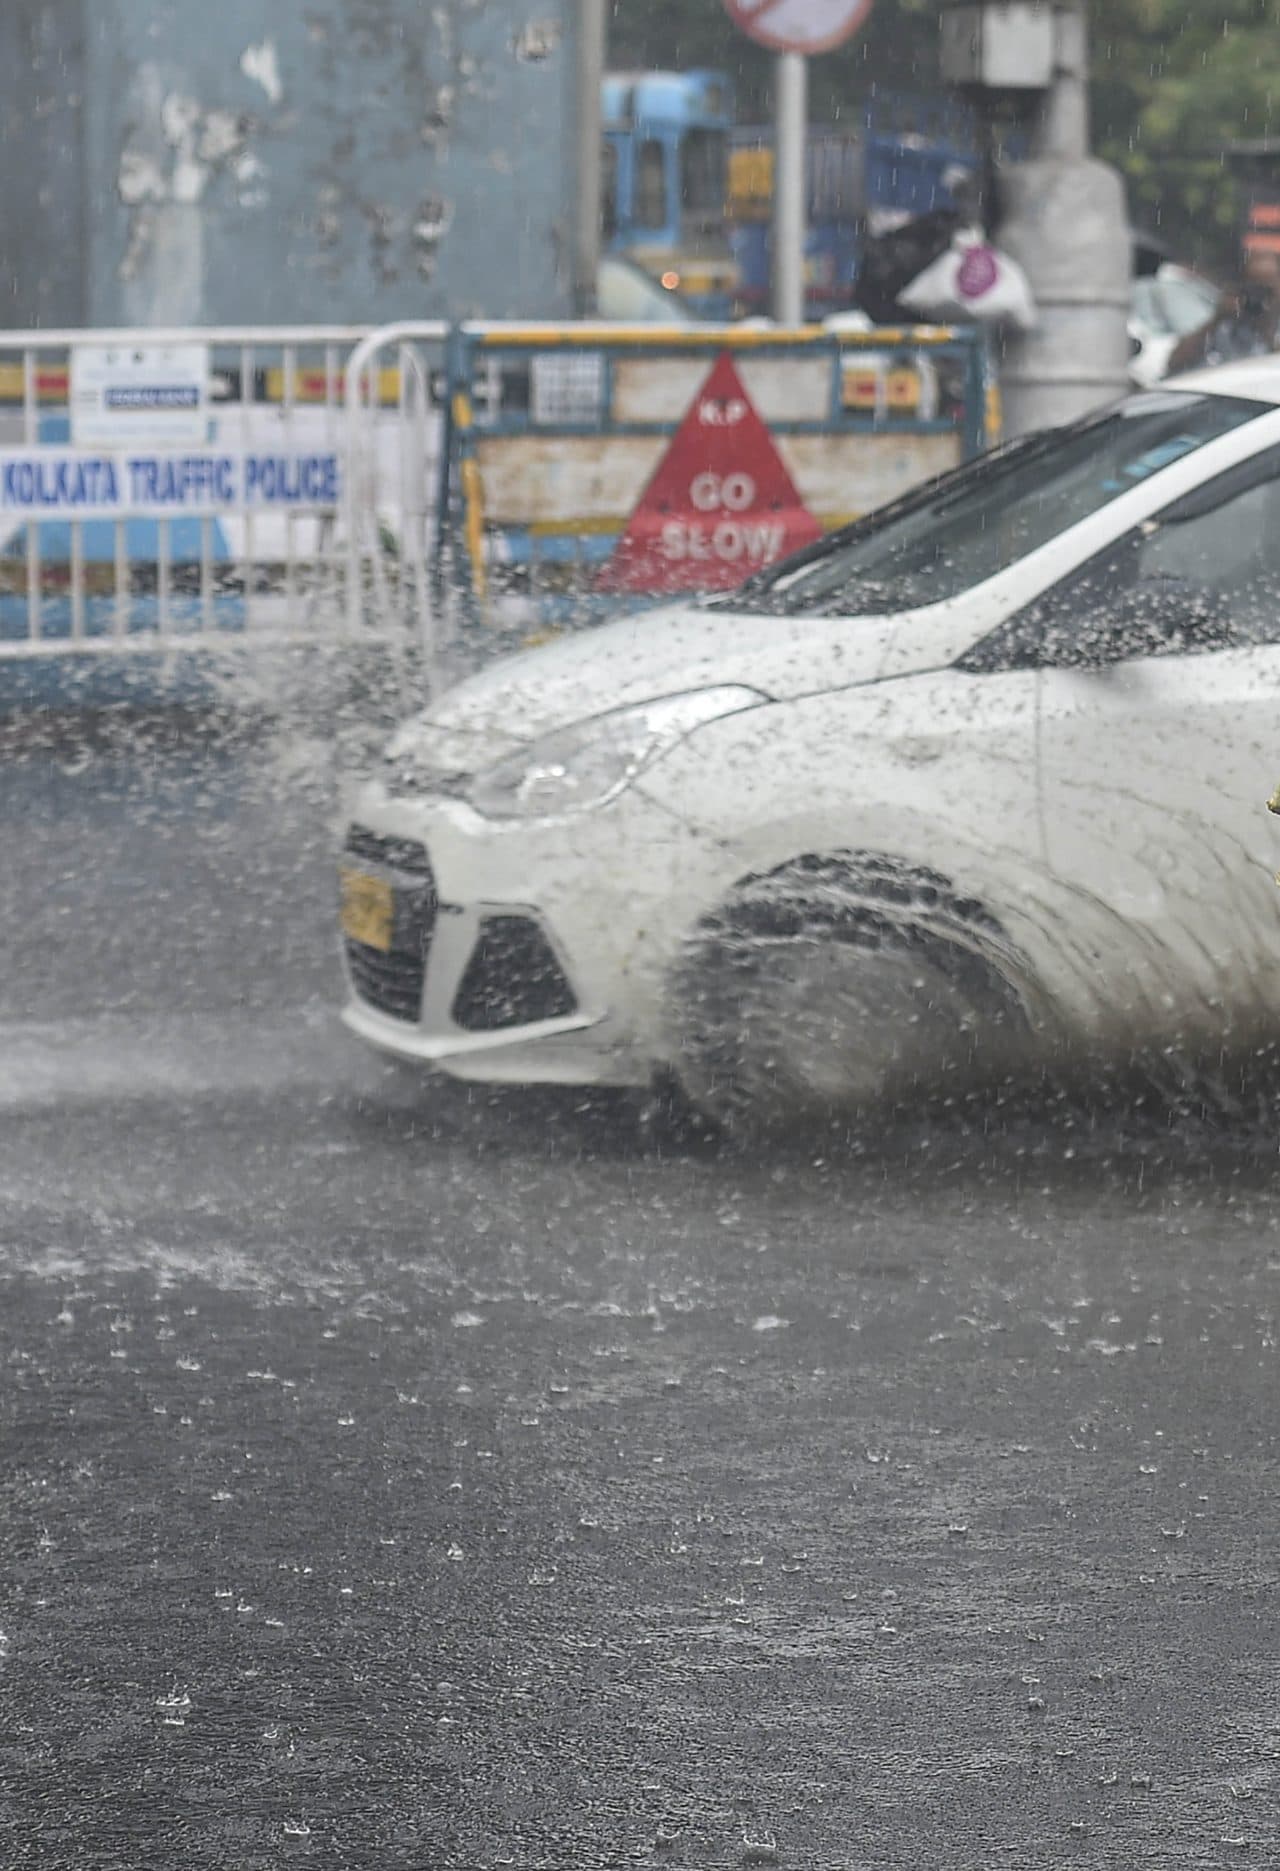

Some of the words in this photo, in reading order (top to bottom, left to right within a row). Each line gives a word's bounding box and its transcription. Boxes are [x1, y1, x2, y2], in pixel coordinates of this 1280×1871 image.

[4, 457, 119, 504] KOLKATA
[127, 456, 235, 503] TRAFFIC
[245, 455, 338, 503] POLICE
[690, 472, 756, 512] GO
[661, 520, 786, 563] SLOW
